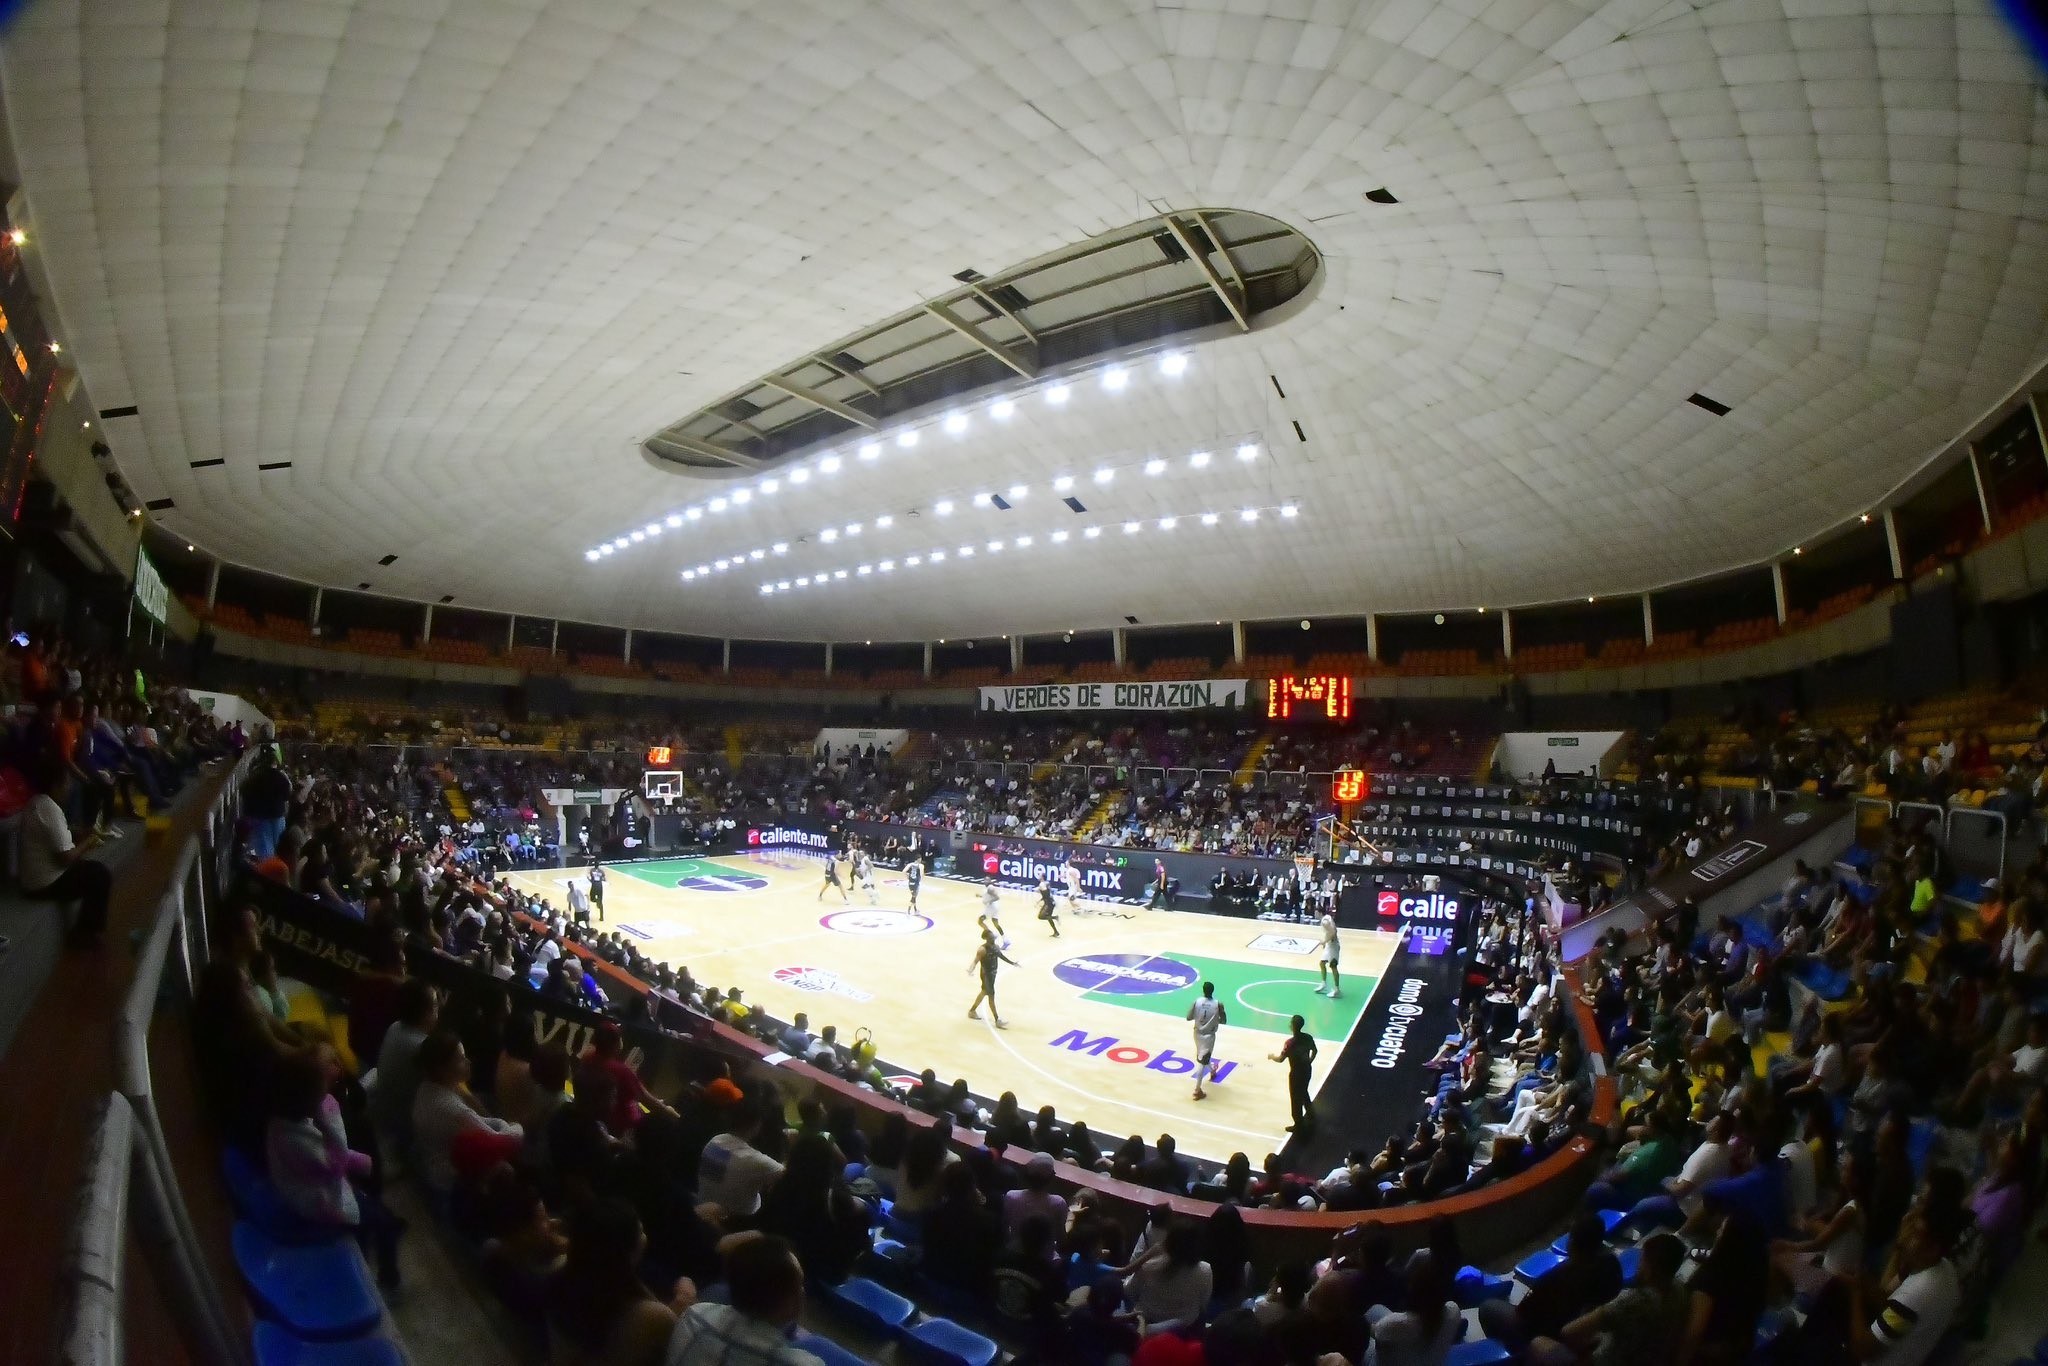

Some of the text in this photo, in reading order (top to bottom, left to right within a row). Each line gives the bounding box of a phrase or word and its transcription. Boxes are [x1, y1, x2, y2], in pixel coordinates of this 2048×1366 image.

[1003, 682, 1212, 710] VERDES DE CORAZÓN
[1337, 782, 1359, 798] 23
[759, 827, 828, 848] caliente.mx
[1354, 826, 1417, 837] TERRAZA
[1427, 828, 1462, 838] CAJA
[1471, 830, 1528, 844] POPULAR
[1399, 894, 1458, 920] calie
[1397, 978, 1429, 1003] domo
[1371, 1016, 1415, 1069] tvcuatro
